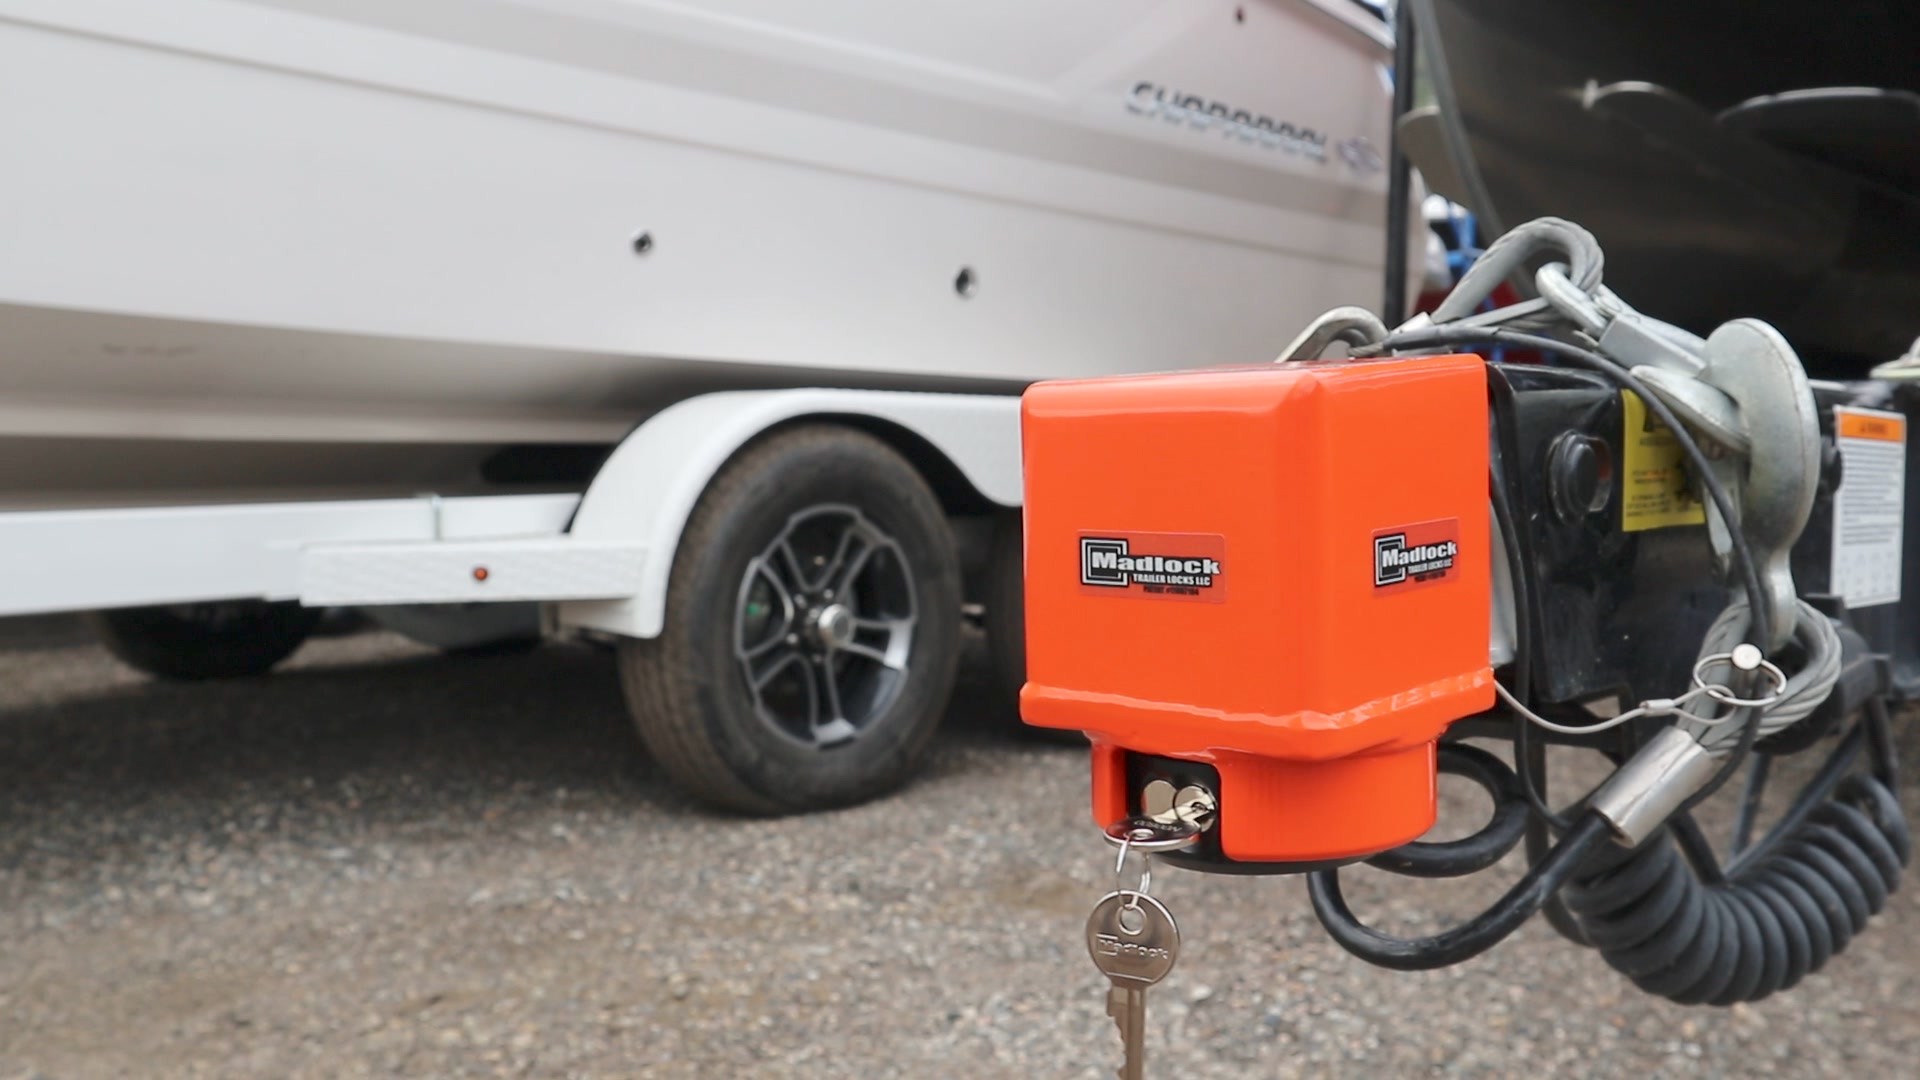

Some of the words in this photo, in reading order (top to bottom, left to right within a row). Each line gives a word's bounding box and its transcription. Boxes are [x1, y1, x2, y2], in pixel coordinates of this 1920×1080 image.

[1091, 551, 1221, 575] Madlock
[1382, 541, 1457, 567] Madlock
[1133, 573, 1166, 583] TRAILER
[1167, 574, 1195, 585] LOCKS
[1195, 576, 1211, 586] LLC
[1098, 938, 1169, 960] Madlock
